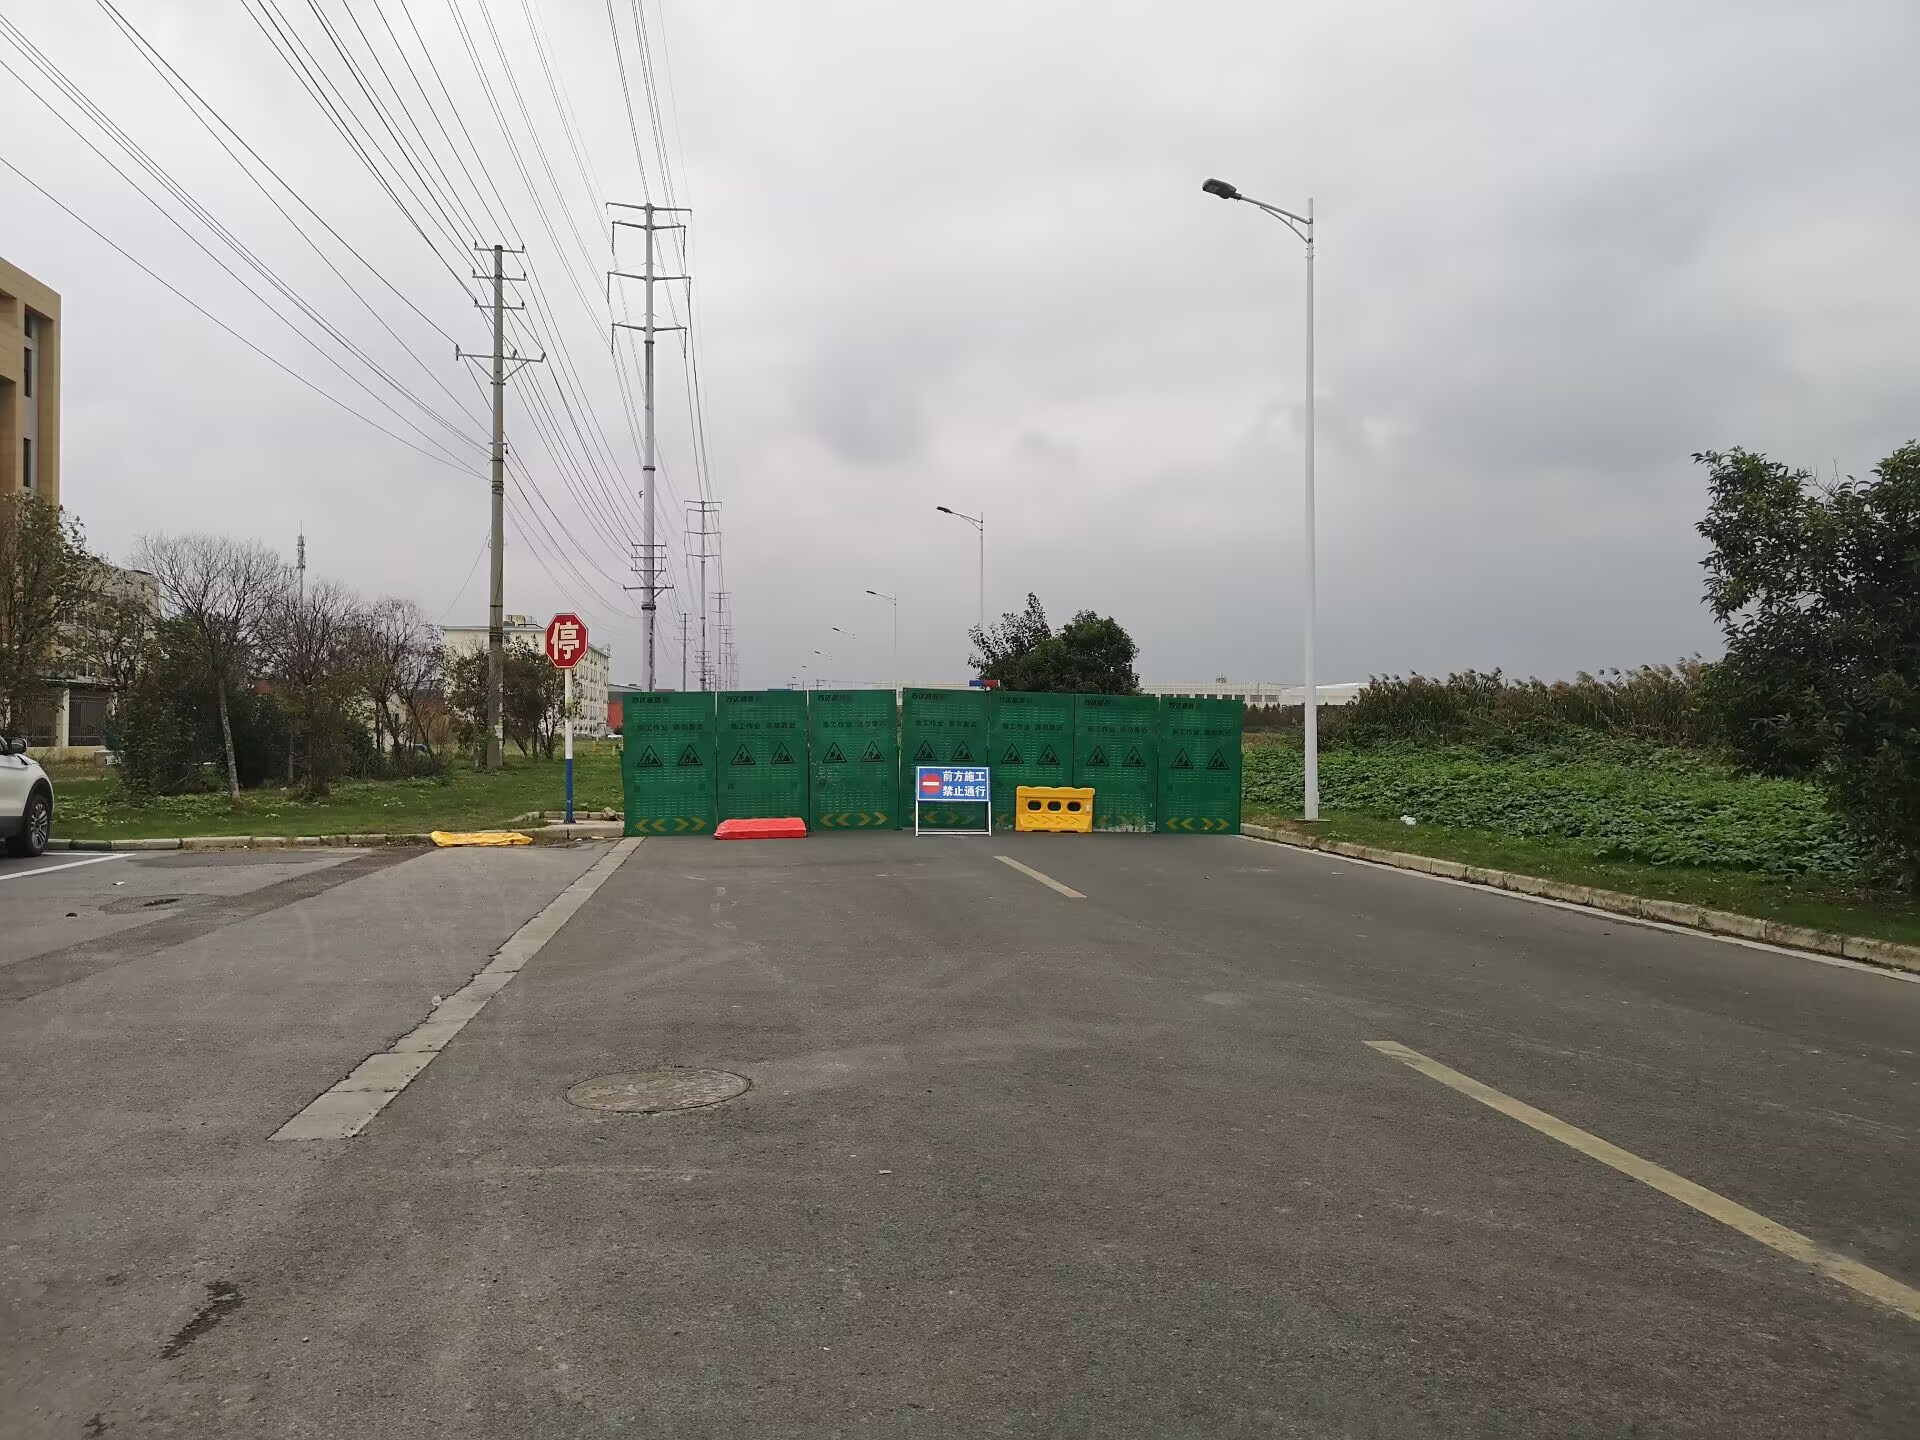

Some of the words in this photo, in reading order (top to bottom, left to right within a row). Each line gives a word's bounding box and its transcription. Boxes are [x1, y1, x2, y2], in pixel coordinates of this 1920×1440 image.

[550, 621, 580, 660] 停
[942, 770, 986, 782] 前方施工
[942, 785, 986, 797] 禁止通行
